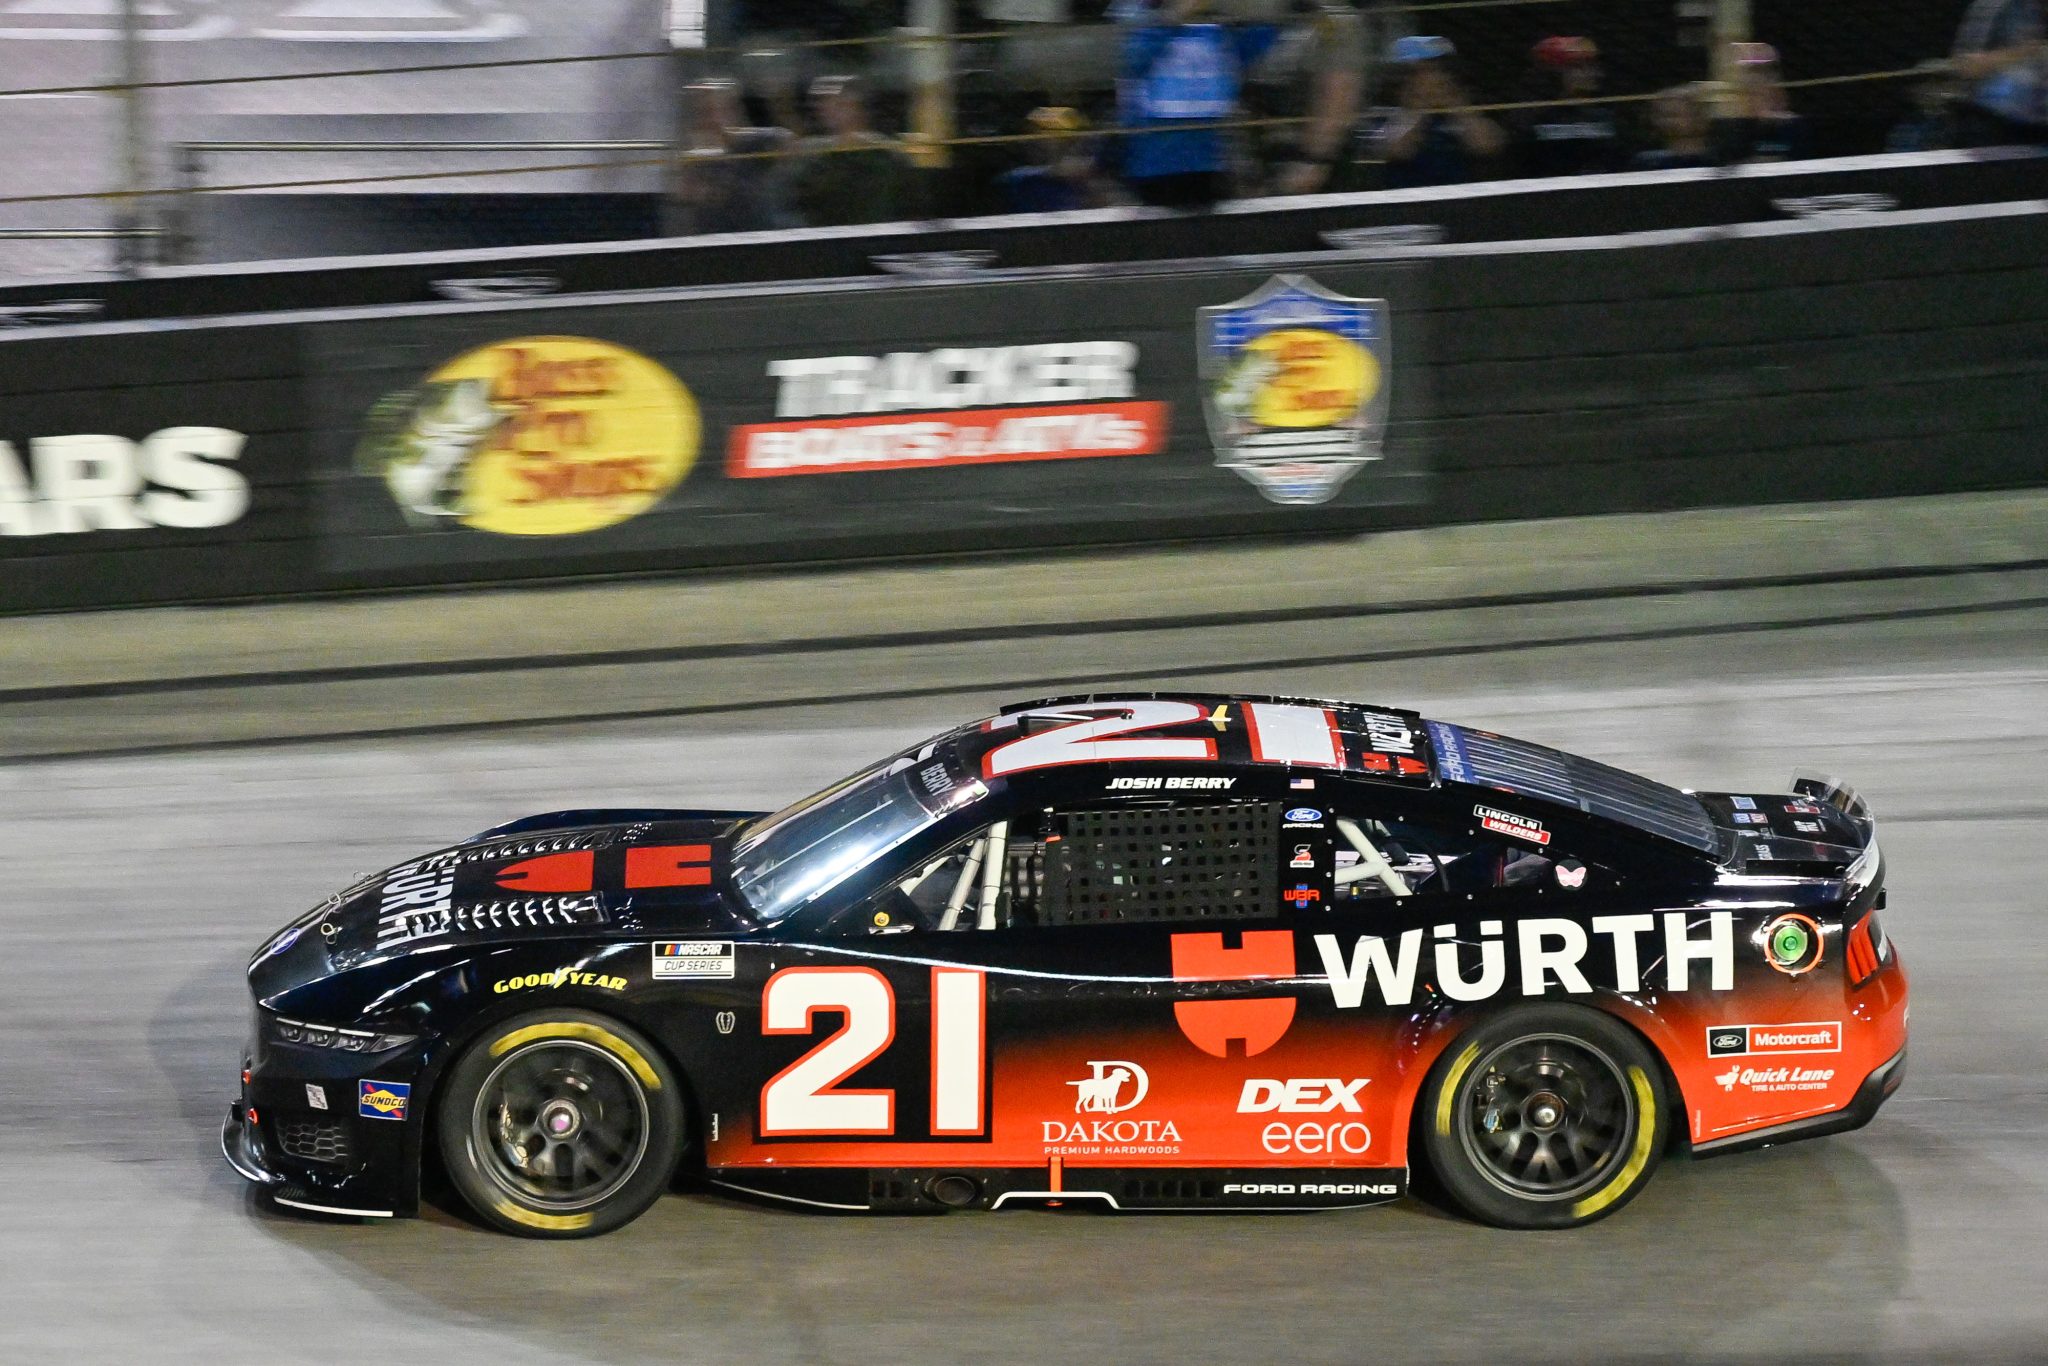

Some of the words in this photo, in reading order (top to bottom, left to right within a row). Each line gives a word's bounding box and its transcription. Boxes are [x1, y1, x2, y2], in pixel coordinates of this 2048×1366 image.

[920, 762, 957, 796] BERRY
[1105, 777, 1163, 789] JOSH
[1165, 777, 1237, 789] BERRY
[1478, 807, 1538, 830] LINCOLN
[1489, 820, 1543, 841] WELDERS
[678, 944, 723, 956] NASCAR
[664, 960, 685, 971] CUP
[686, 960, 723, 971] SERIES
[1313, 911, 1735, 1009] WÜRTH
[1755, 1030, 1833, 1047] Motorcraft
[760, 966, 986, 1137] 21
[1739, 1066, 1790, 1084] Quick
[1789, 1067, 1835, 1082] Lane
[1236, 1078, 1372, 1113] DEX
[1751, 1084, 1768, 1092] TIRE
[1776, 1083, 1796, 1091] AUTO
[1797, 1082, 1828, 1090] CENTER
[363, 1095, 407, 1107] SUNOCO
[1041, 1120, 1183, 1142] DAKOTA
[1261, 1121, 1372, 1154] eero
[1044, 1146, 1100, 1155] PREMIUM
[1104, 1146, 1181, 1155] HARDWOODS
[1223, 1184, 1296, 1195] FORD
[1300, 1184, 1397, 1195] RACING
